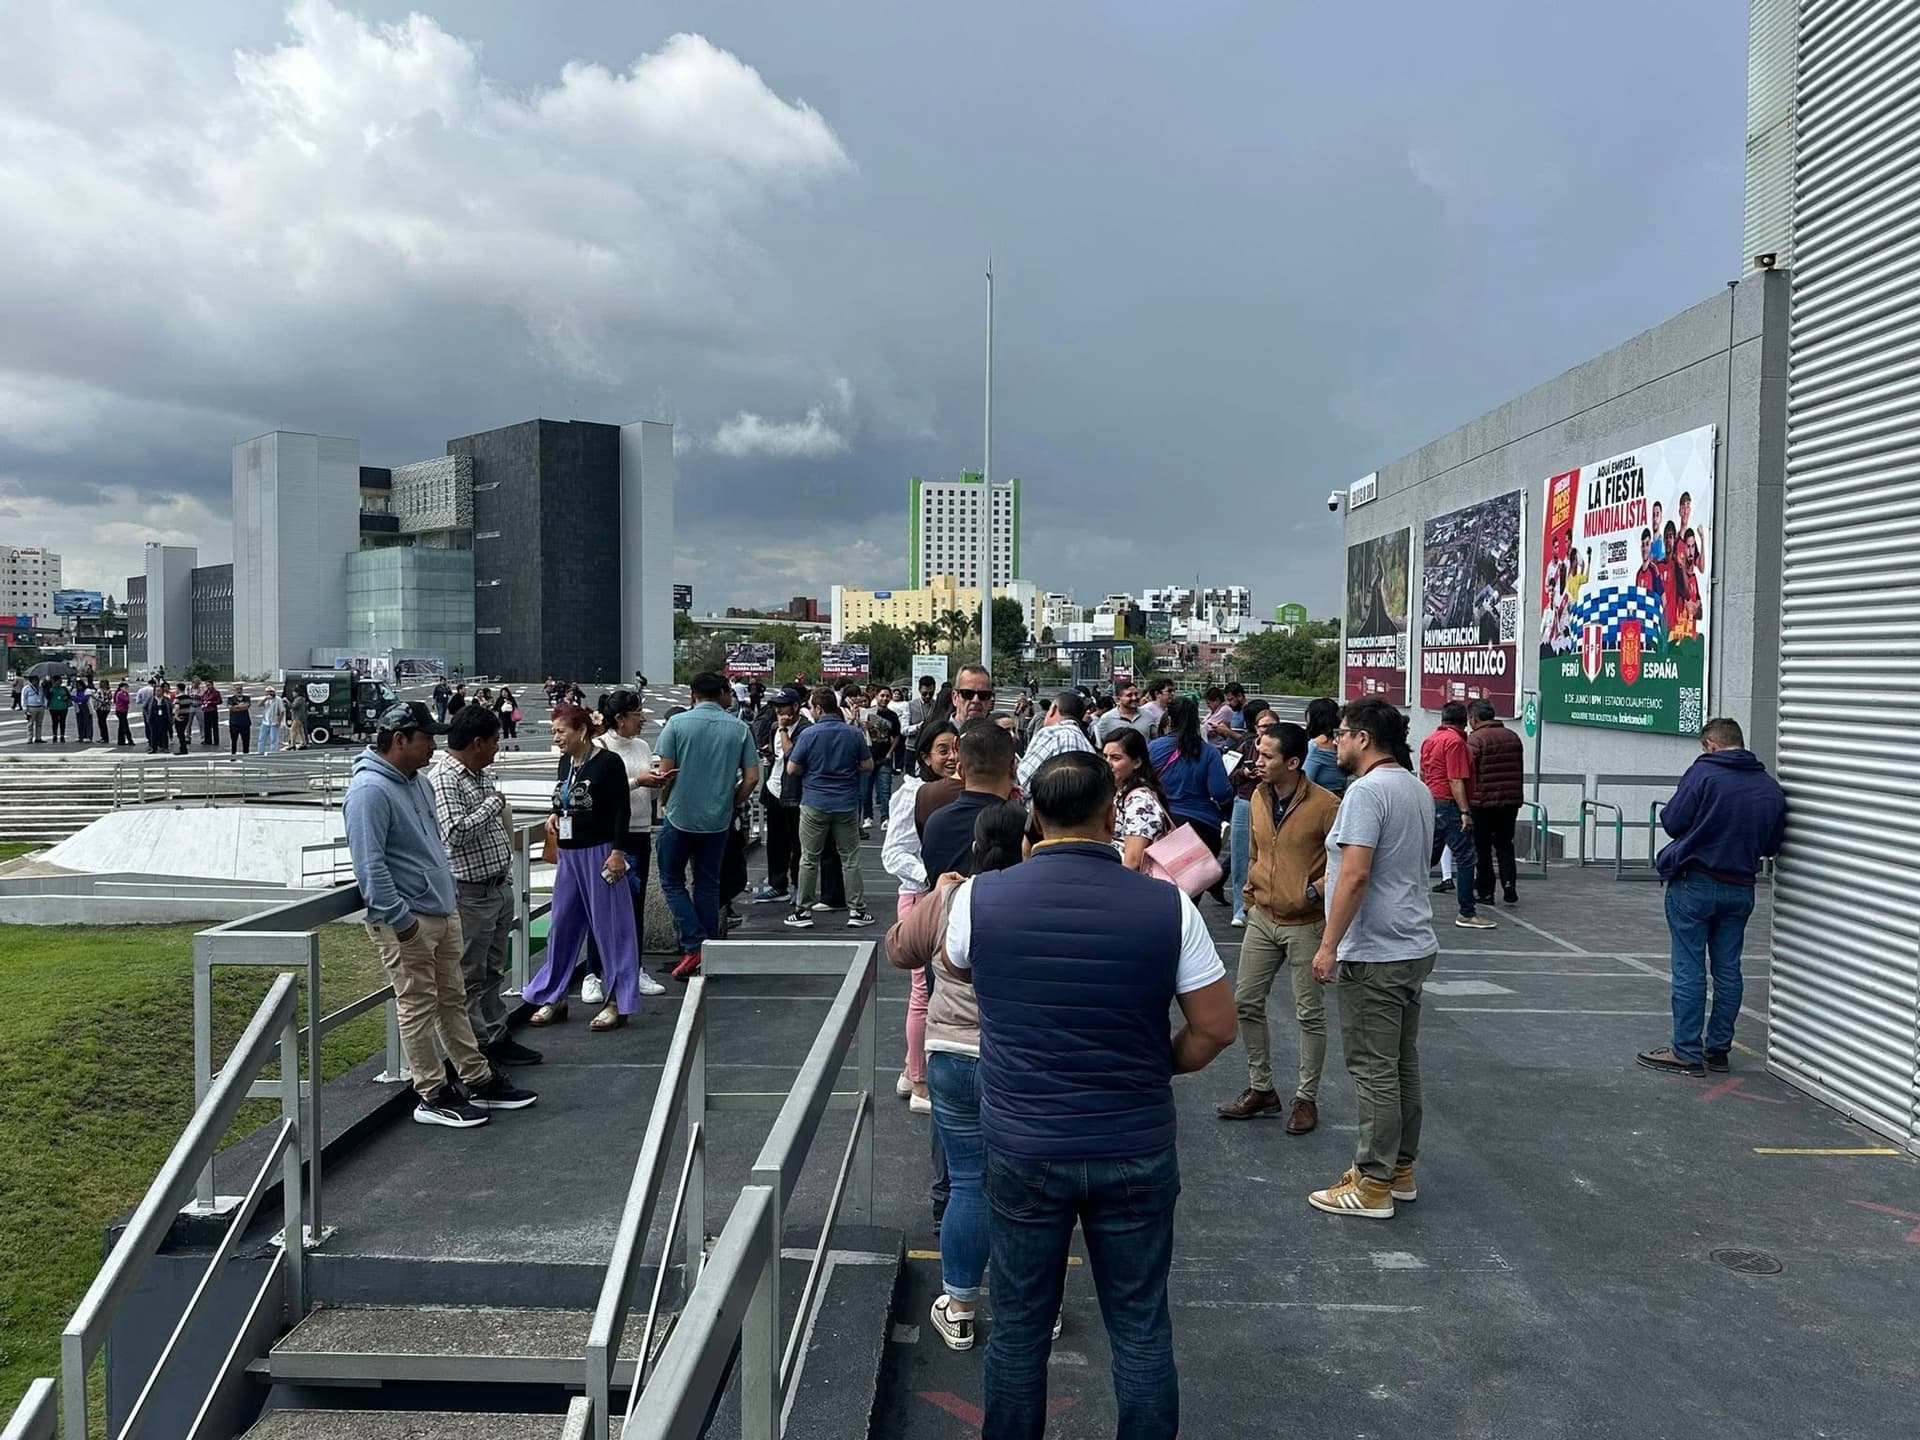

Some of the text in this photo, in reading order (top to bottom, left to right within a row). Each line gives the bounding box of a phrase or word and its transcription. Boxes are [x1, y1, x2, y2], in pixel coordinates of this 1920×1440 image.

[1597, 456, 1636, 478] AQUÍ EMPIEZA
[1588, 479, 1602, 510] LA
[1605, 467, 1645, 506] FIESTA
[1584, 498, 1648, 538] MUNDIALISTA
[1424, 621, 1480, 646] PAVIMENTACIÓN
[1366, 652, 1376, 667] SAN
[1424, 650, 1506, 675] BULEVAR ATLIXCO
[1561, 658, 1678, 679] PERÚ VS ESPAÑA
[1568, 694, 1575, 704] DE
[1574, 695, 1589, 705] JUNIO
[1605, 696, 1625, 707] ESTADIO
[1626, 697, 1664, 710] CUAUHTÉMOC
